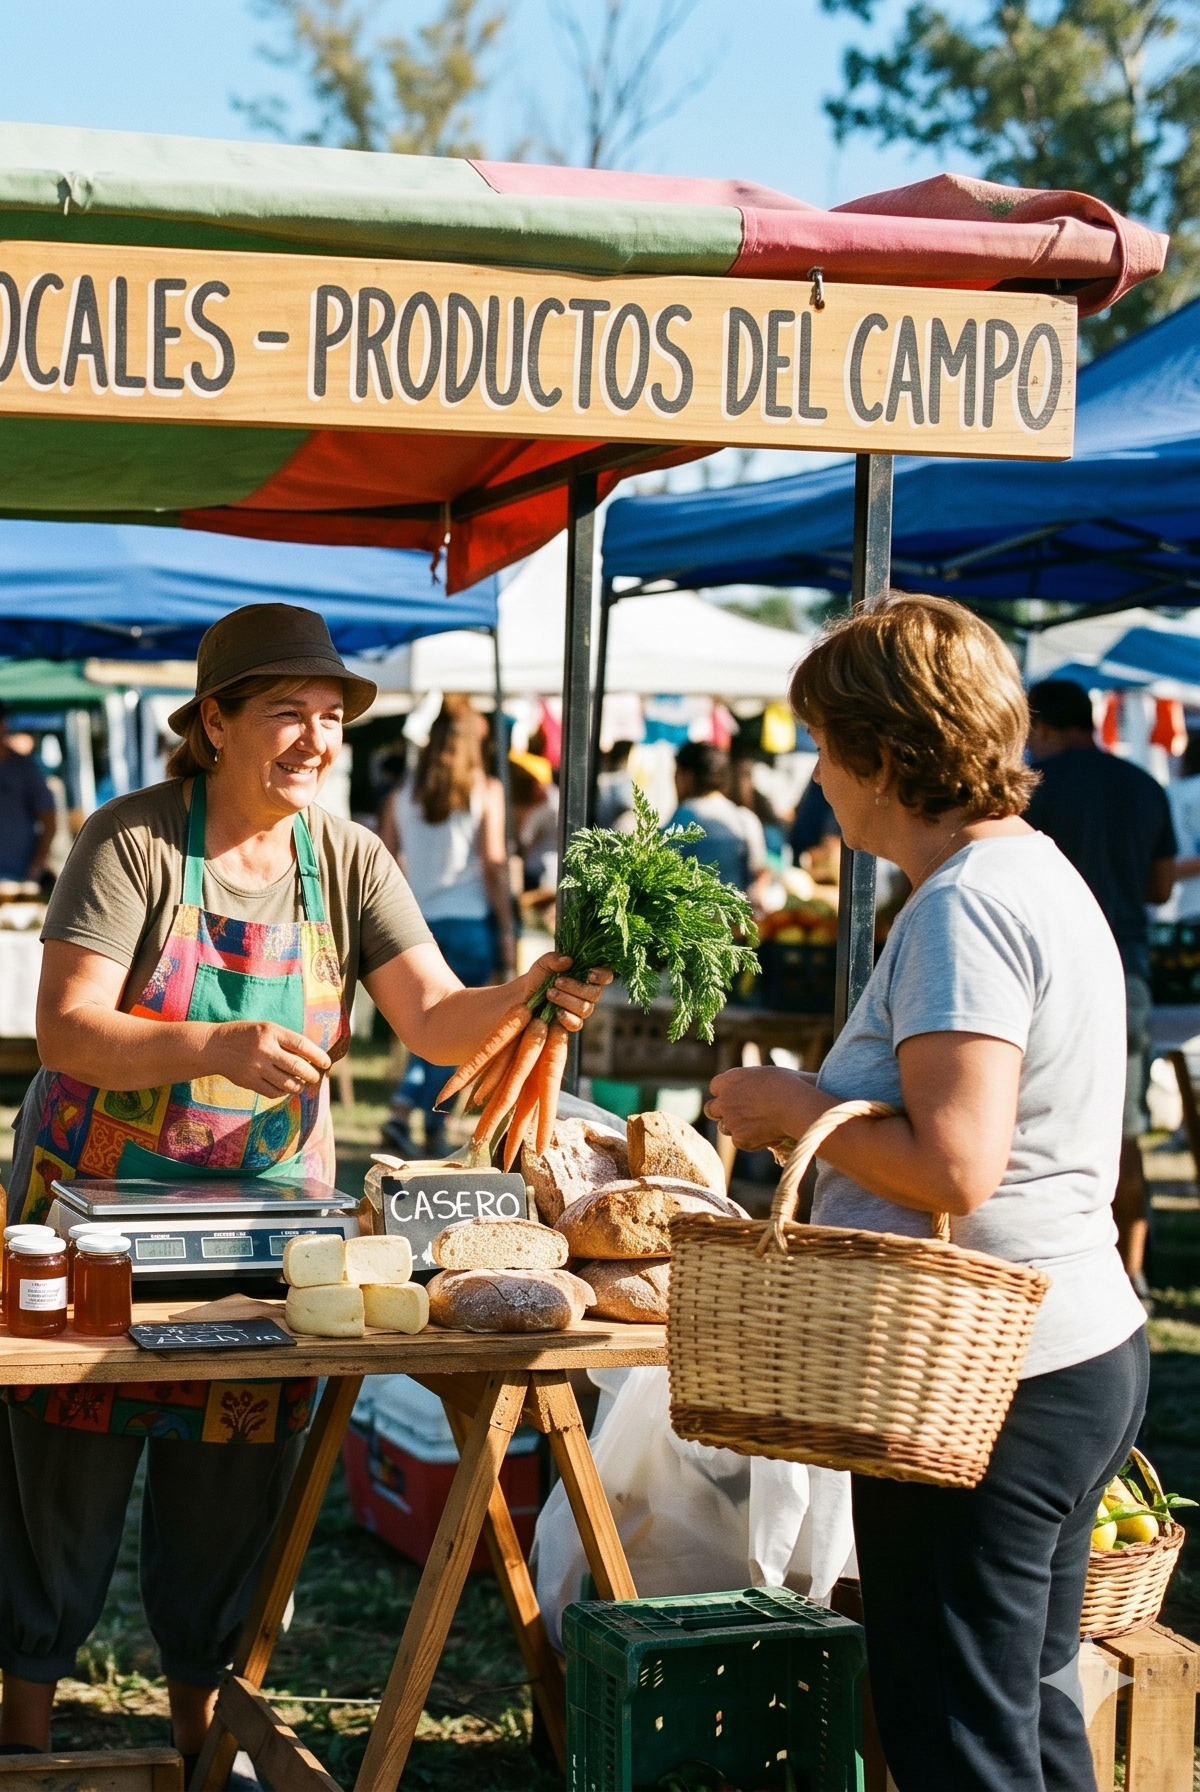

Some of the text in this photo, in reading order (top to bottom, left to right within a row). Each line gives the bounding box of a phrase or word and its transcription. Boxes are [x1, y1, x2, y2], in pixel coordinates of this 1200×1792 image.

[310, 285, 694, 416] PRODUCTOS
[723, 306, 828, 424] DEL
[846, 312, 1063, 432] CAMPO
[390, 1190, 520, 1222] CASERO
